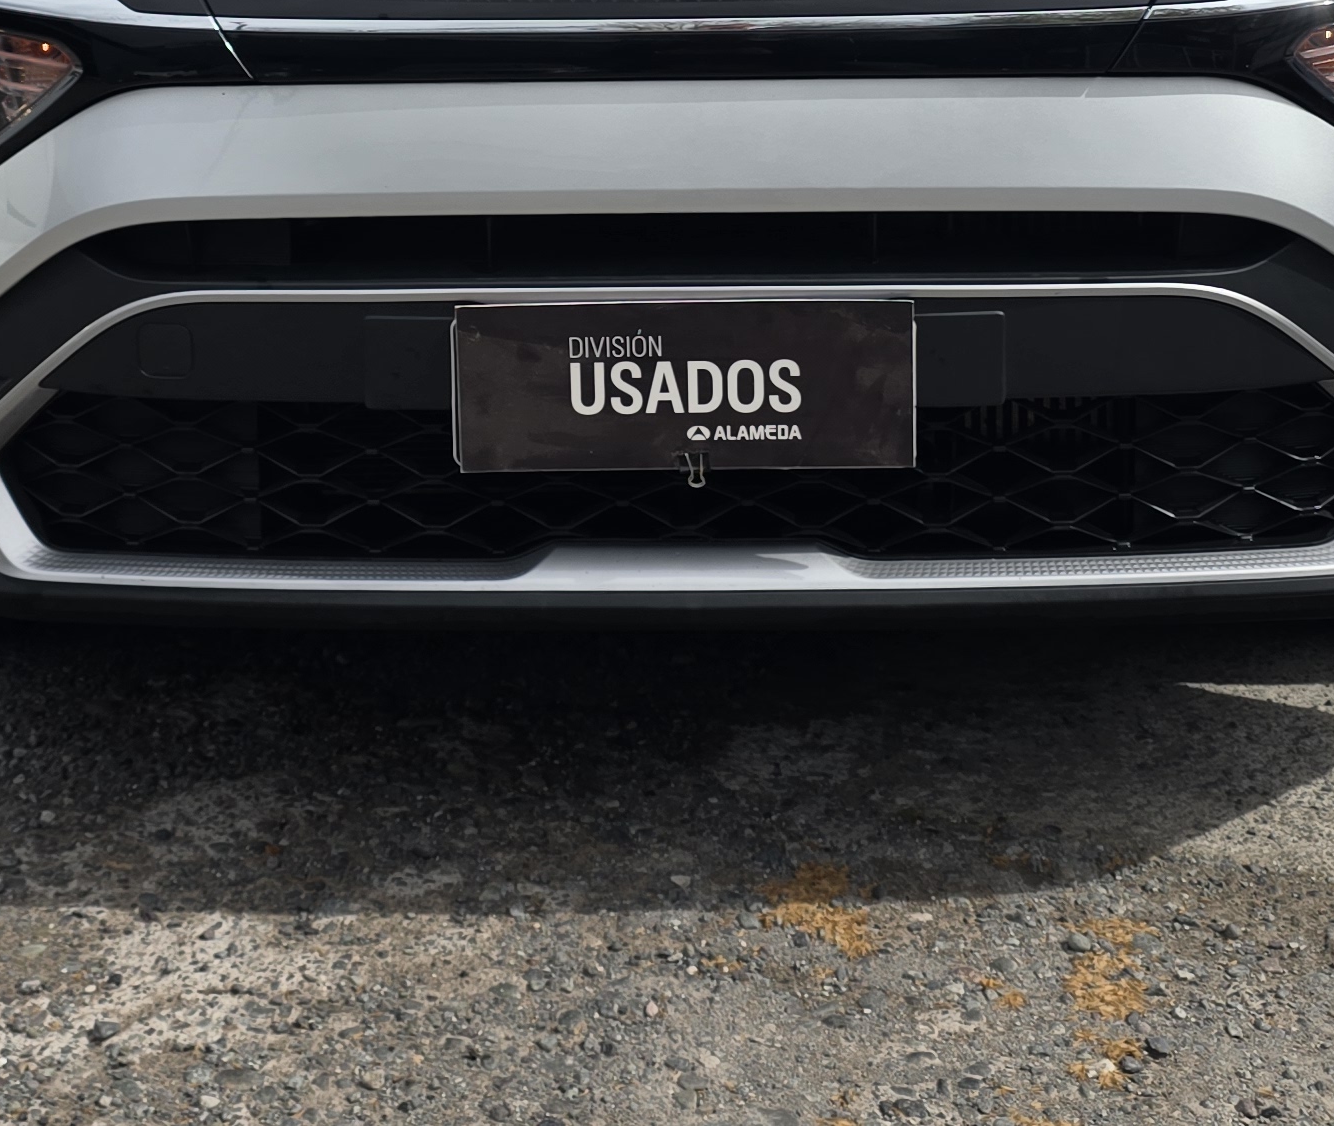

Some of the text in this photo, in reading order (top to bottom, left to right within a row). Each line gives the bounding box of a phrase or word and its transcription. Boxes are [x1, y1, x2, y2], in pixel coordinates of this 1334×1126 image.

[568, 329, 663, 359] DIVISIÓN
[569, 358, 802, 416] USADOS
[713, 424, 802, 442] ALAMEDA
